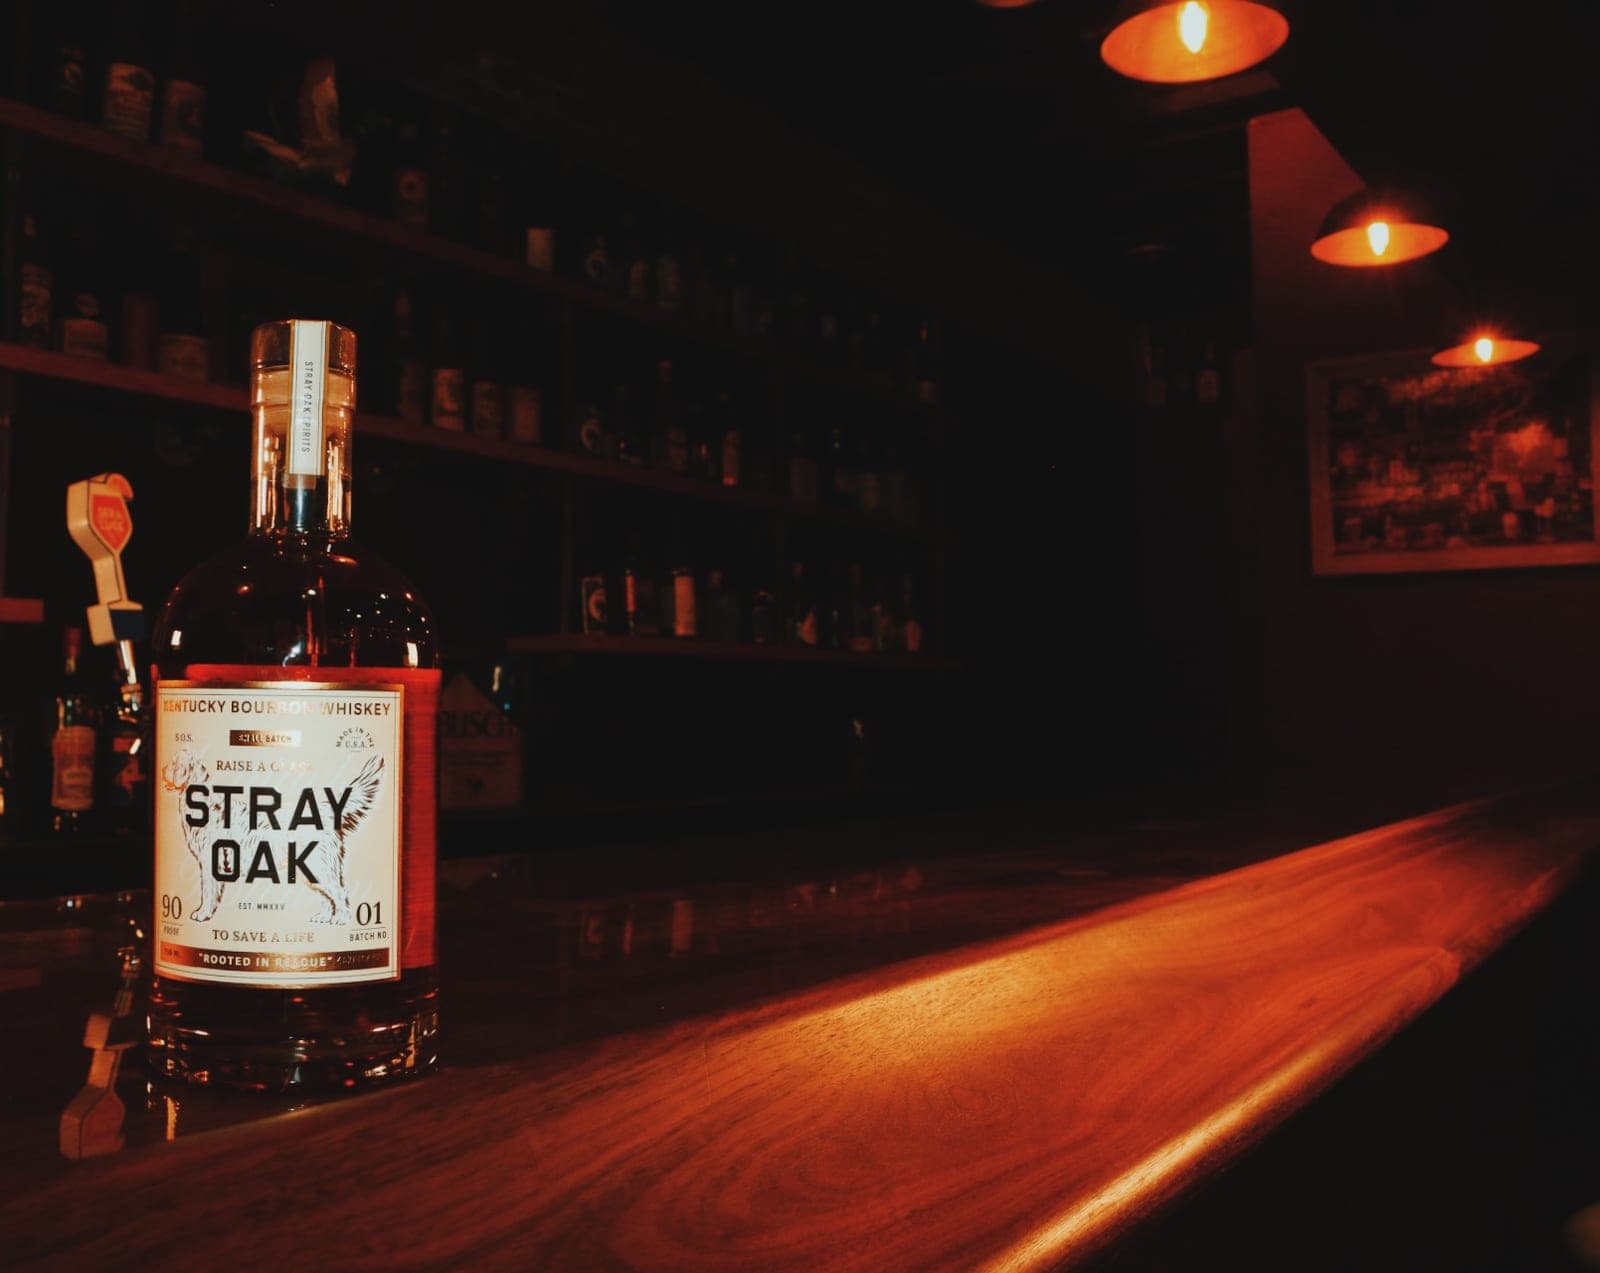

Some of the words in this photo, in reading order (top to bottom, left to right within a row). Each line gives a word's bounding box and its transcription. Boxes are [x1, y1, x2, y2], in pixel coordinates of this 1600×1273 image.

[303, 361, 314, 390] STRAY
[303, 393, 312, 412] OAK
[163, 699, 225, 713] KENTUCKY
[320, 702, 390, 716] WHISKEY
[265, 734, 293, 744] BATCH
[216, 760, 253, 772] RAISE
[257, 761, 267, 772] A
[185, 785, 352, 829] STRAY
[212, 839, 319, 884] OAK
[162, 894, 182, 920] 90
[356, 901, 383, 926] 01
[212, 929, 229, 941] TO
[232, 931, 267, 943] SAVE
[270, 932, 280, 943] A
[284, 932, 315, 943] LIFE
[349, 932, 375, 942] BATCH
[255, 957, 270, 967] IN
